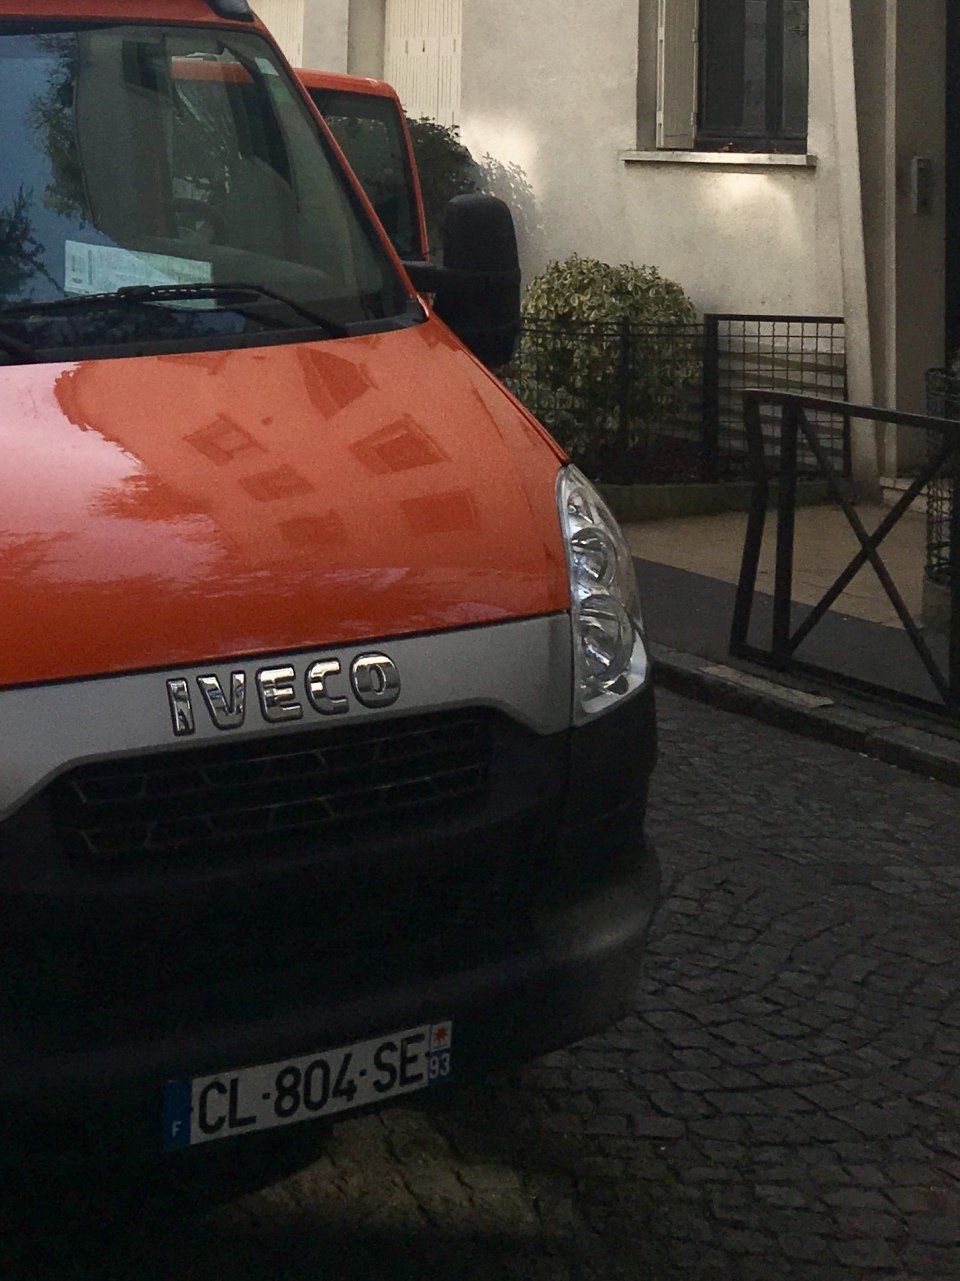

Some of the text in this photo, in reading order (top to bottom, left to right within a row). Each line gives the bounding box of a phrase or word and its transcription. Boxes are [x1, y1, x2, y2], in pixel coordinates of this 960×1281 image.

[166, 650, 401, 736] IVECO
[171, 1120, 182, 1137] F
[428, 1052, 450, 1080] 93
